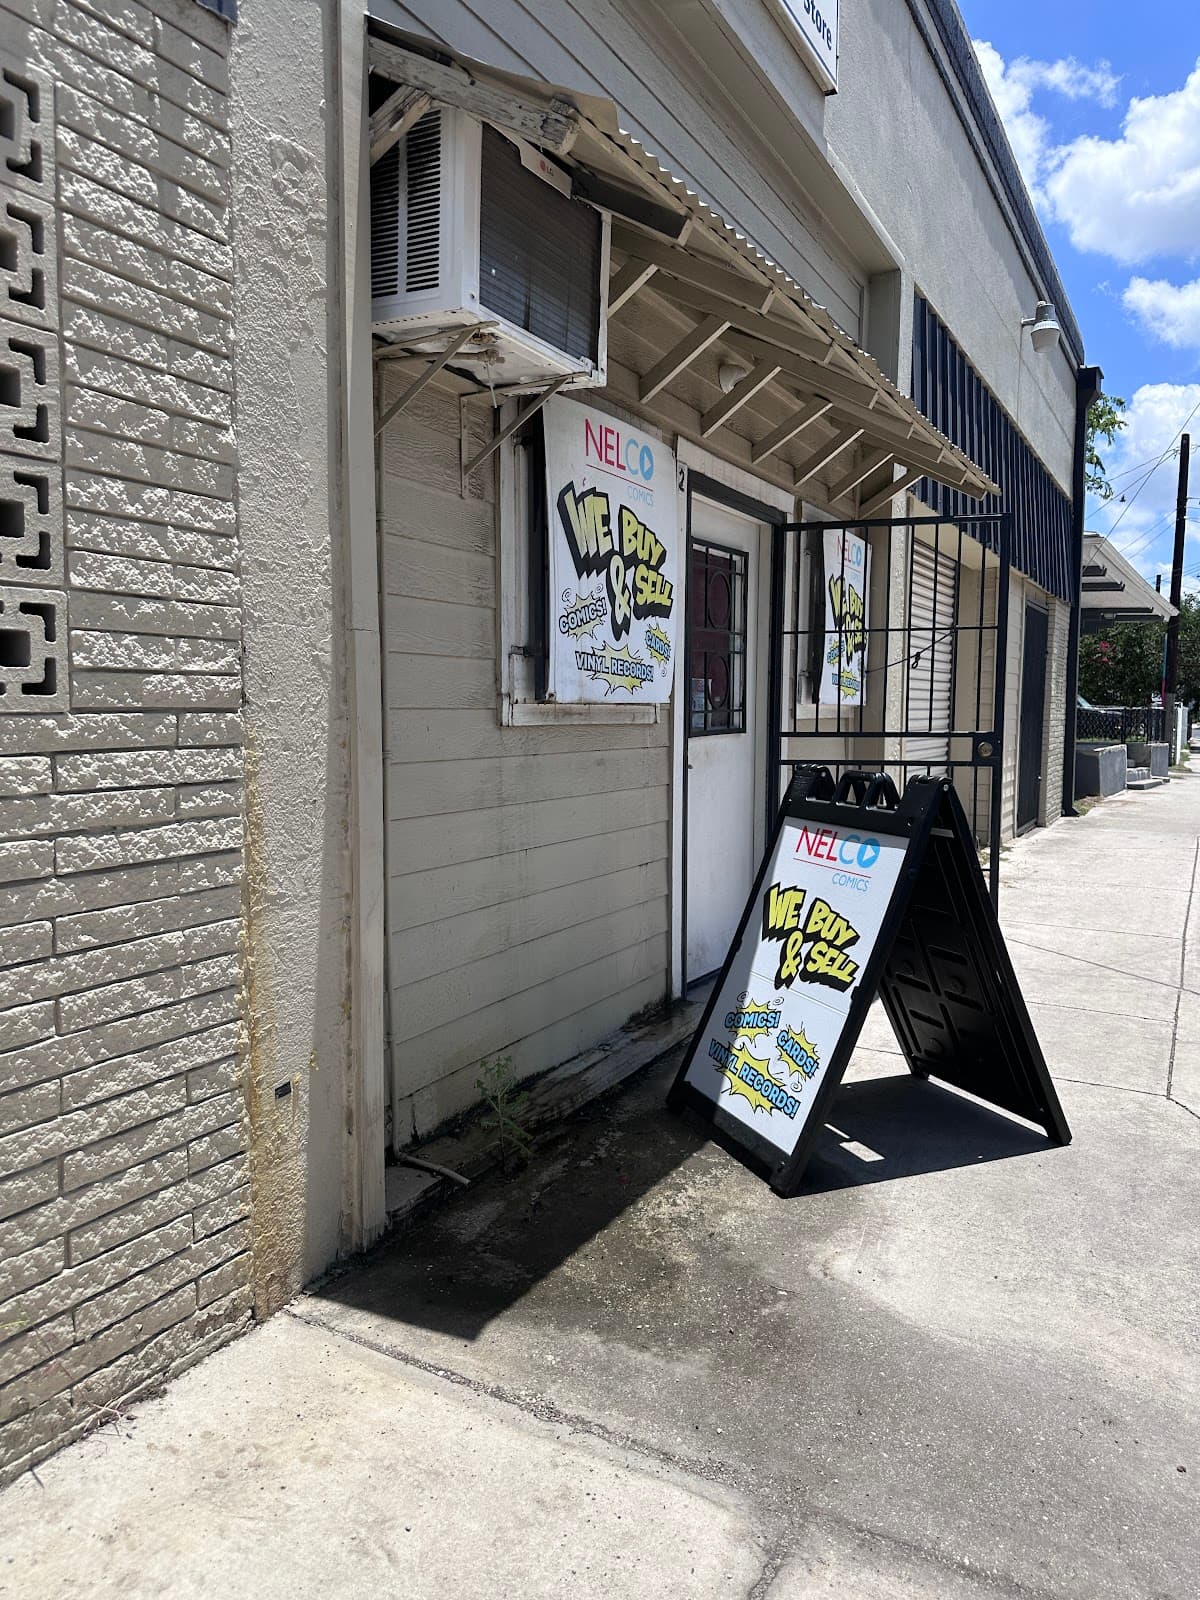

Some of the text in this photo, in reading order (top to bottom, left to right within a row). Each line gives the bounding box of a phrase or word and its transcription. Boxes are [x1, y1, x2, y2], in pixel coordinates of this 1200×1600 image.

[585, 418, 654, 481] NELCO
[626, 485, 654, 508] COMICS
[678, 468, 685, 492] 2
[559, 484, 666, 567] WE BUY
[608, 552, 673, 632] & SELL
[558, 597, 607, 634] COMICS!
[575, 651, 654, 682] VINYL RECORDS!
[796, 825, 880, 868] NELCO
[832, 873, 870, 892] COMICS
[765, 884, 859, 948] WE BUY
[778, 930, 859, 986] & SELL
[724, 1011, 781, 1028] COMICS!
[776, 1030, 819, 1079] CARDS!
[708, 1039, 801, 1120] VINYL RECORDS!
